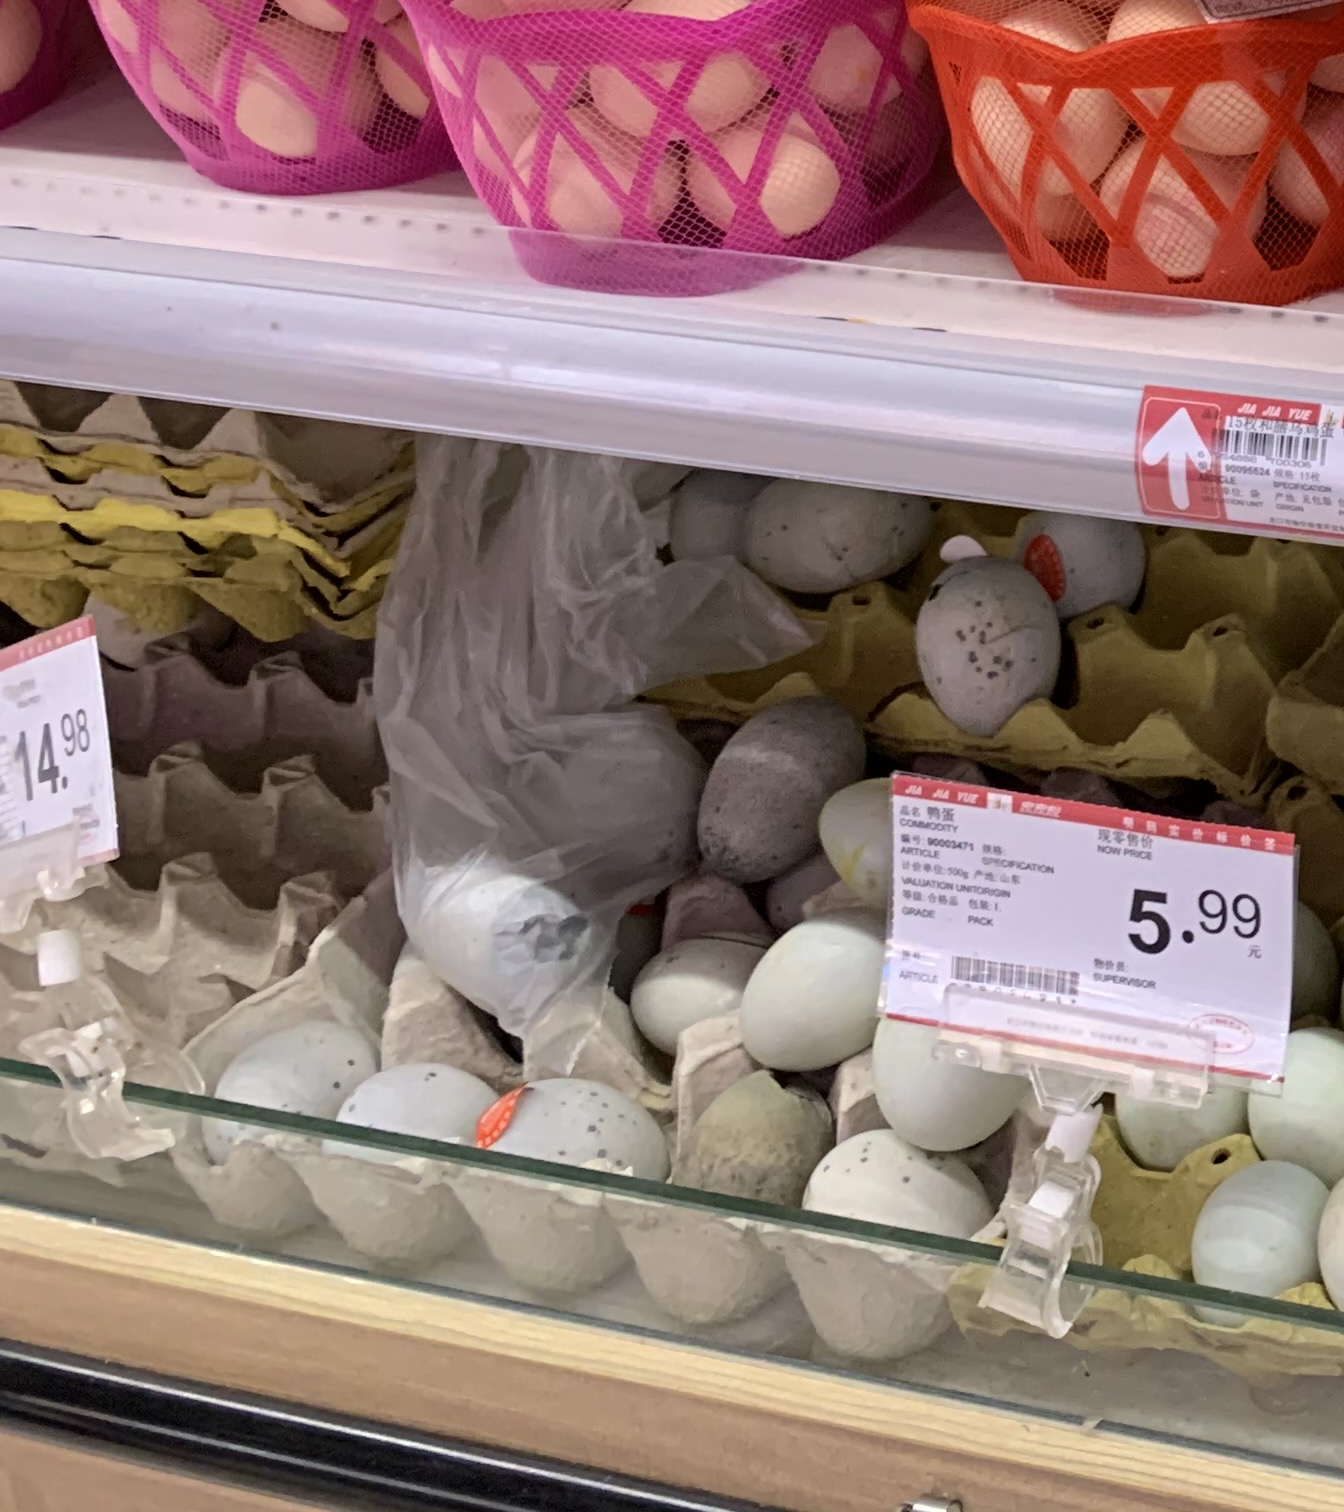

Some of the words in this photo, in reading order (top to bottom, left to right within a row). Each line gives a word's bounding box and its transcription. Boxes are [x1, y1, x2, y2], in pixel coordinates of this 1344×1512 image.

[1238, 403, 1257, 414] JIA
[1262, 406, 1281, 417] JIA
[1288, 408, 1312, 420] YUE
[15, 708, 91, 801] 14.98
[905, 785, 923, 796] JIA
[932, 788, 950, 799] JIA
[957, 792, 979, 803] YUE
[926, 806, 955, 822] 鸭蛋
[1098, 829, 1153, 849] 现零售价
[900, 819, 958, 833] COMMODITY
[1097, 845, 1121, 856] NOW
[1124, 849, 1153, 861] PRICE
[927, 837, 974, 851] 90003471
[900, 847, 940, 859] ARTICLE
[982, 857, 1055, 874] SPECIFICATION
[901, 877, 954, 891] VALUATION
[902, 906, 936, 918] GRADE
[968, 915, 994, 926] PACK
[1128, 888, 1261, 955] 5.99
[1248, 945, 1262, 959] 元
[900, 970, 939, 984] ARTICLE
[1093, 973, 1157, 990] SUPERVISOR
